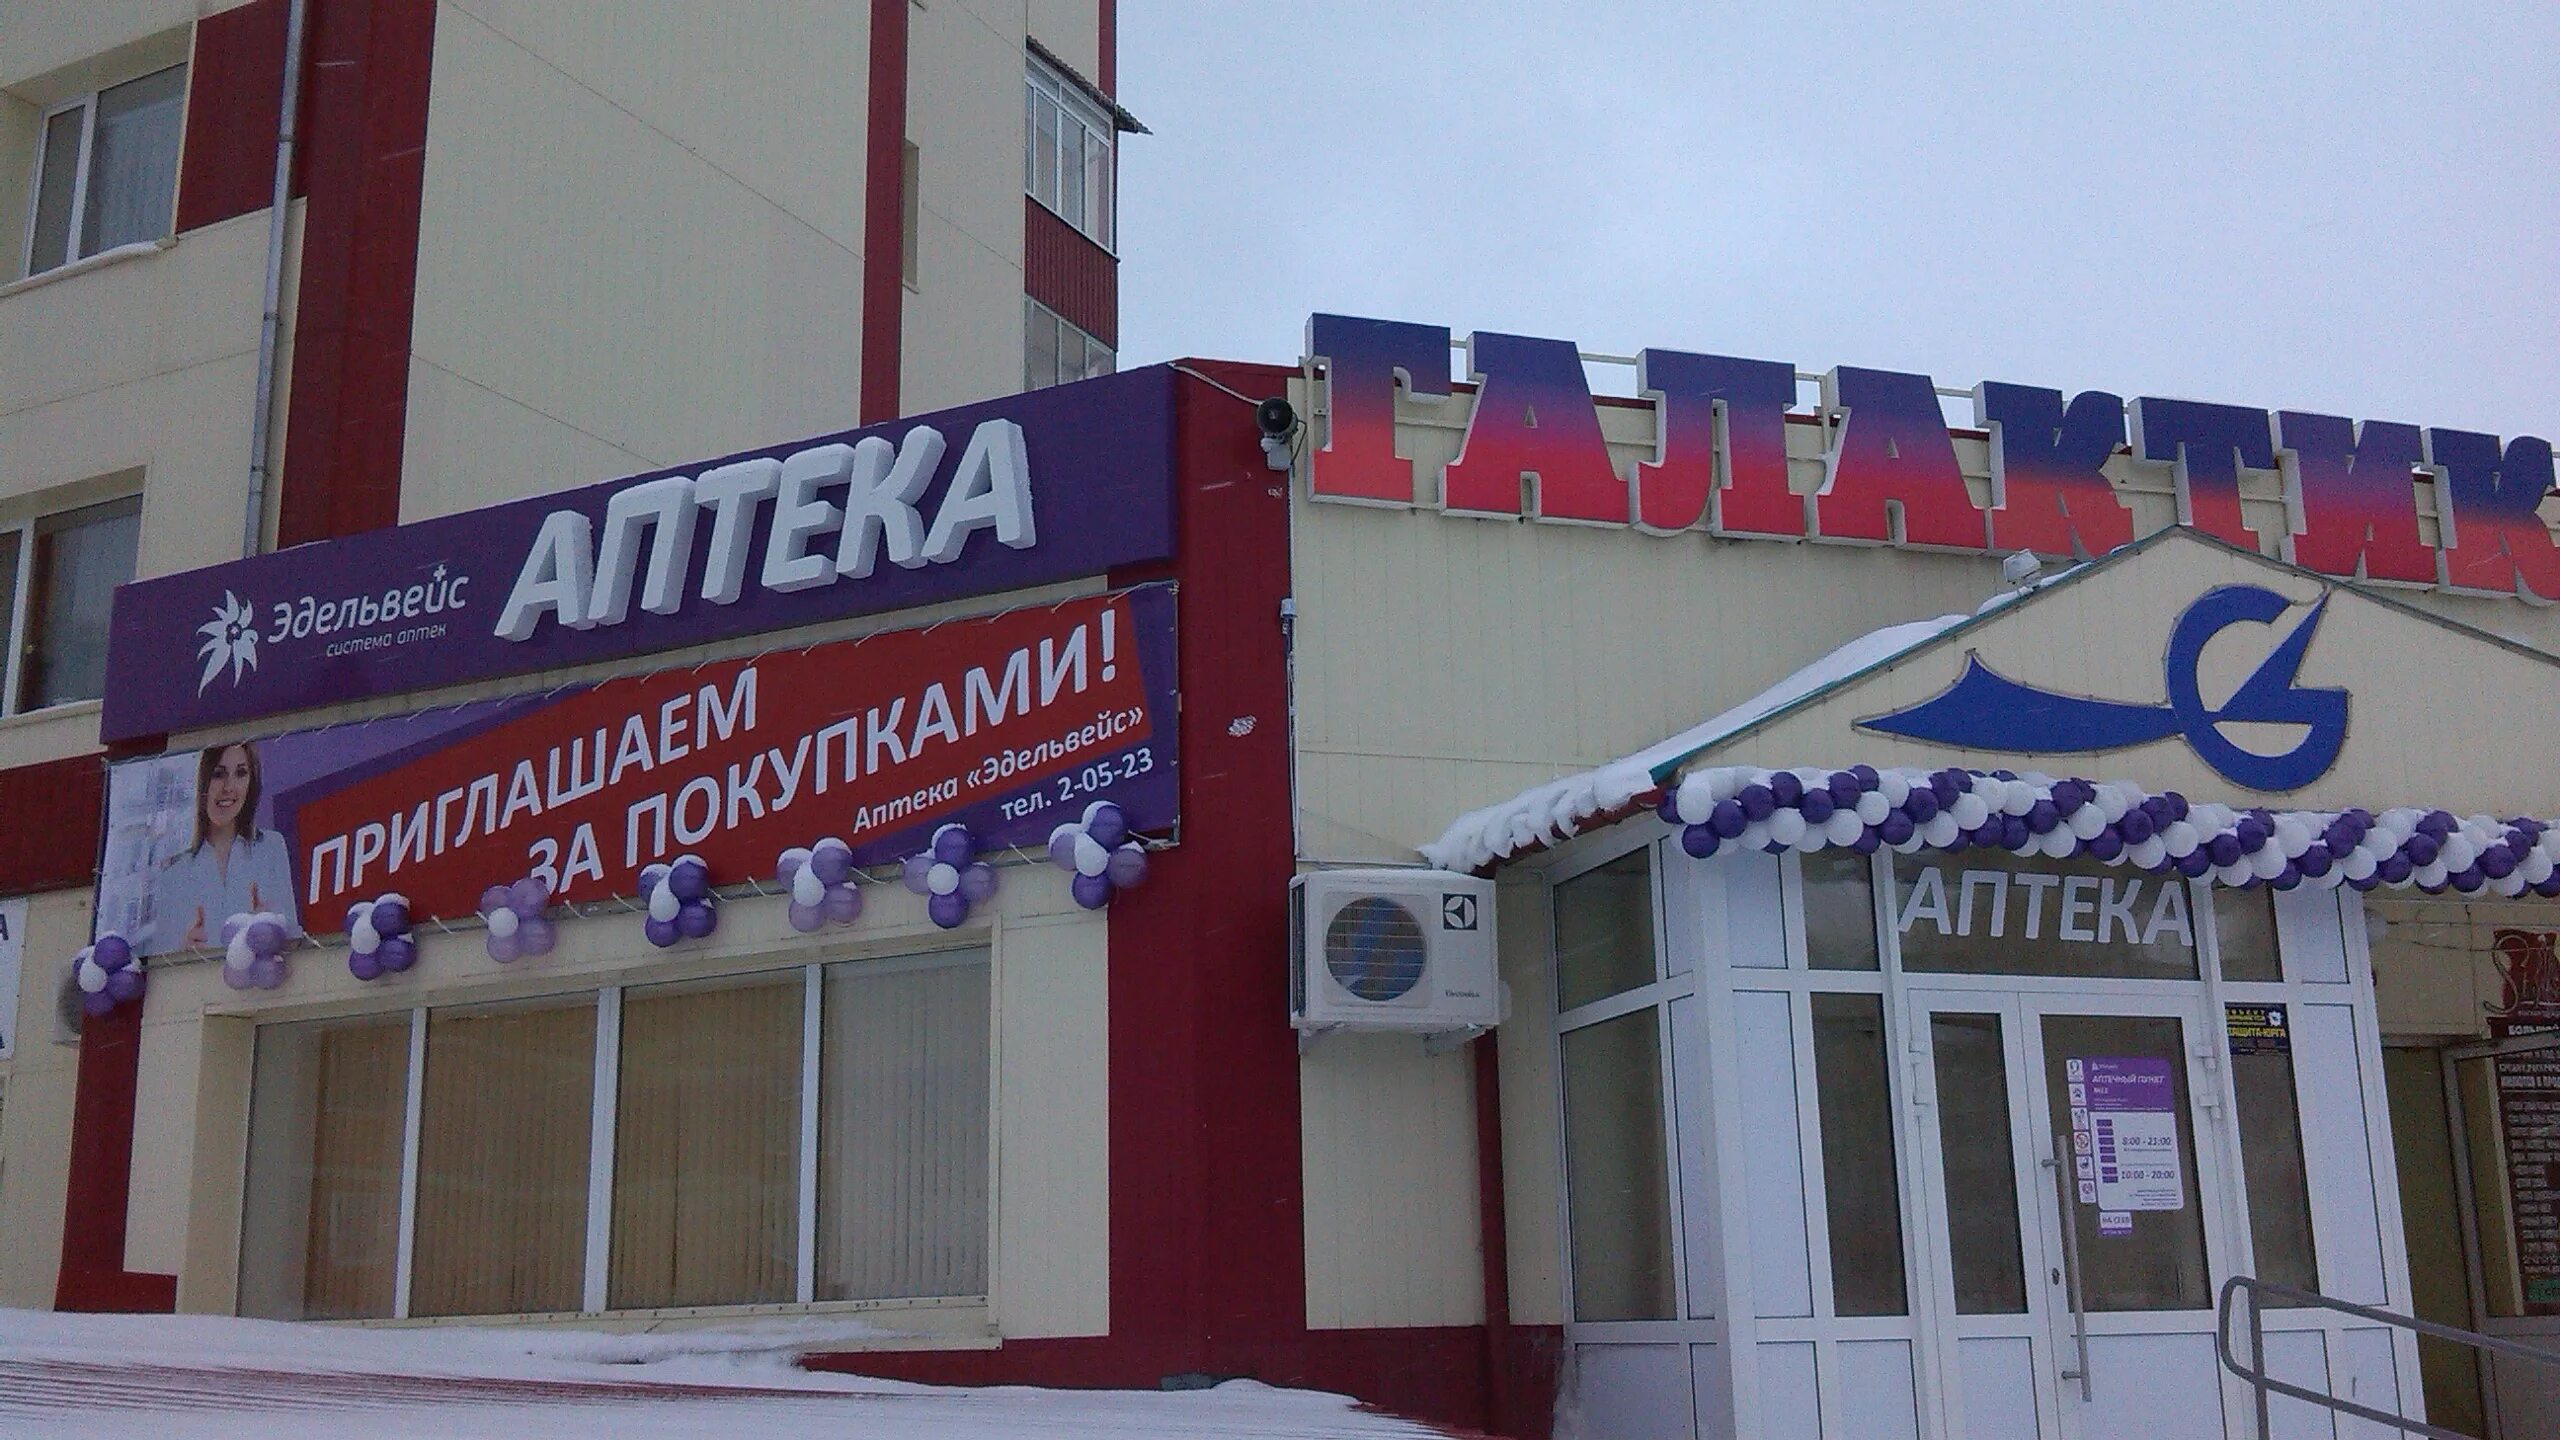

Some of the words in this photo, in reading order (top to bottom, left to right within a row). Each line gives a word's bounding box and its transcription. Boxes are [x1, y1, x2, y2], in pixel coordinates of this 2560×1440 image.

[493, 418, 1037, 641] АПТЕКА
[267, 564, 469, 644] Эдельвейс
[326, 628, 392, 658] система
[396, 622, 447, 645] аптек
[308, 667, 758, 905] ПРИГЛАШАЕМ
[528, 822, 605, 895] ЗА
[625, 608, 1116, 869] ПОКУПКАМИ!
[852, 776, 959, 835] Аптека
[965, 704, 1144, 788] «Эдельвейс»
[1000, 787, 1052, 822] тел.
[1057, 746, 1155, 803] 2-05-23
[1898, 867, 2195, 948] АПТЕКА
